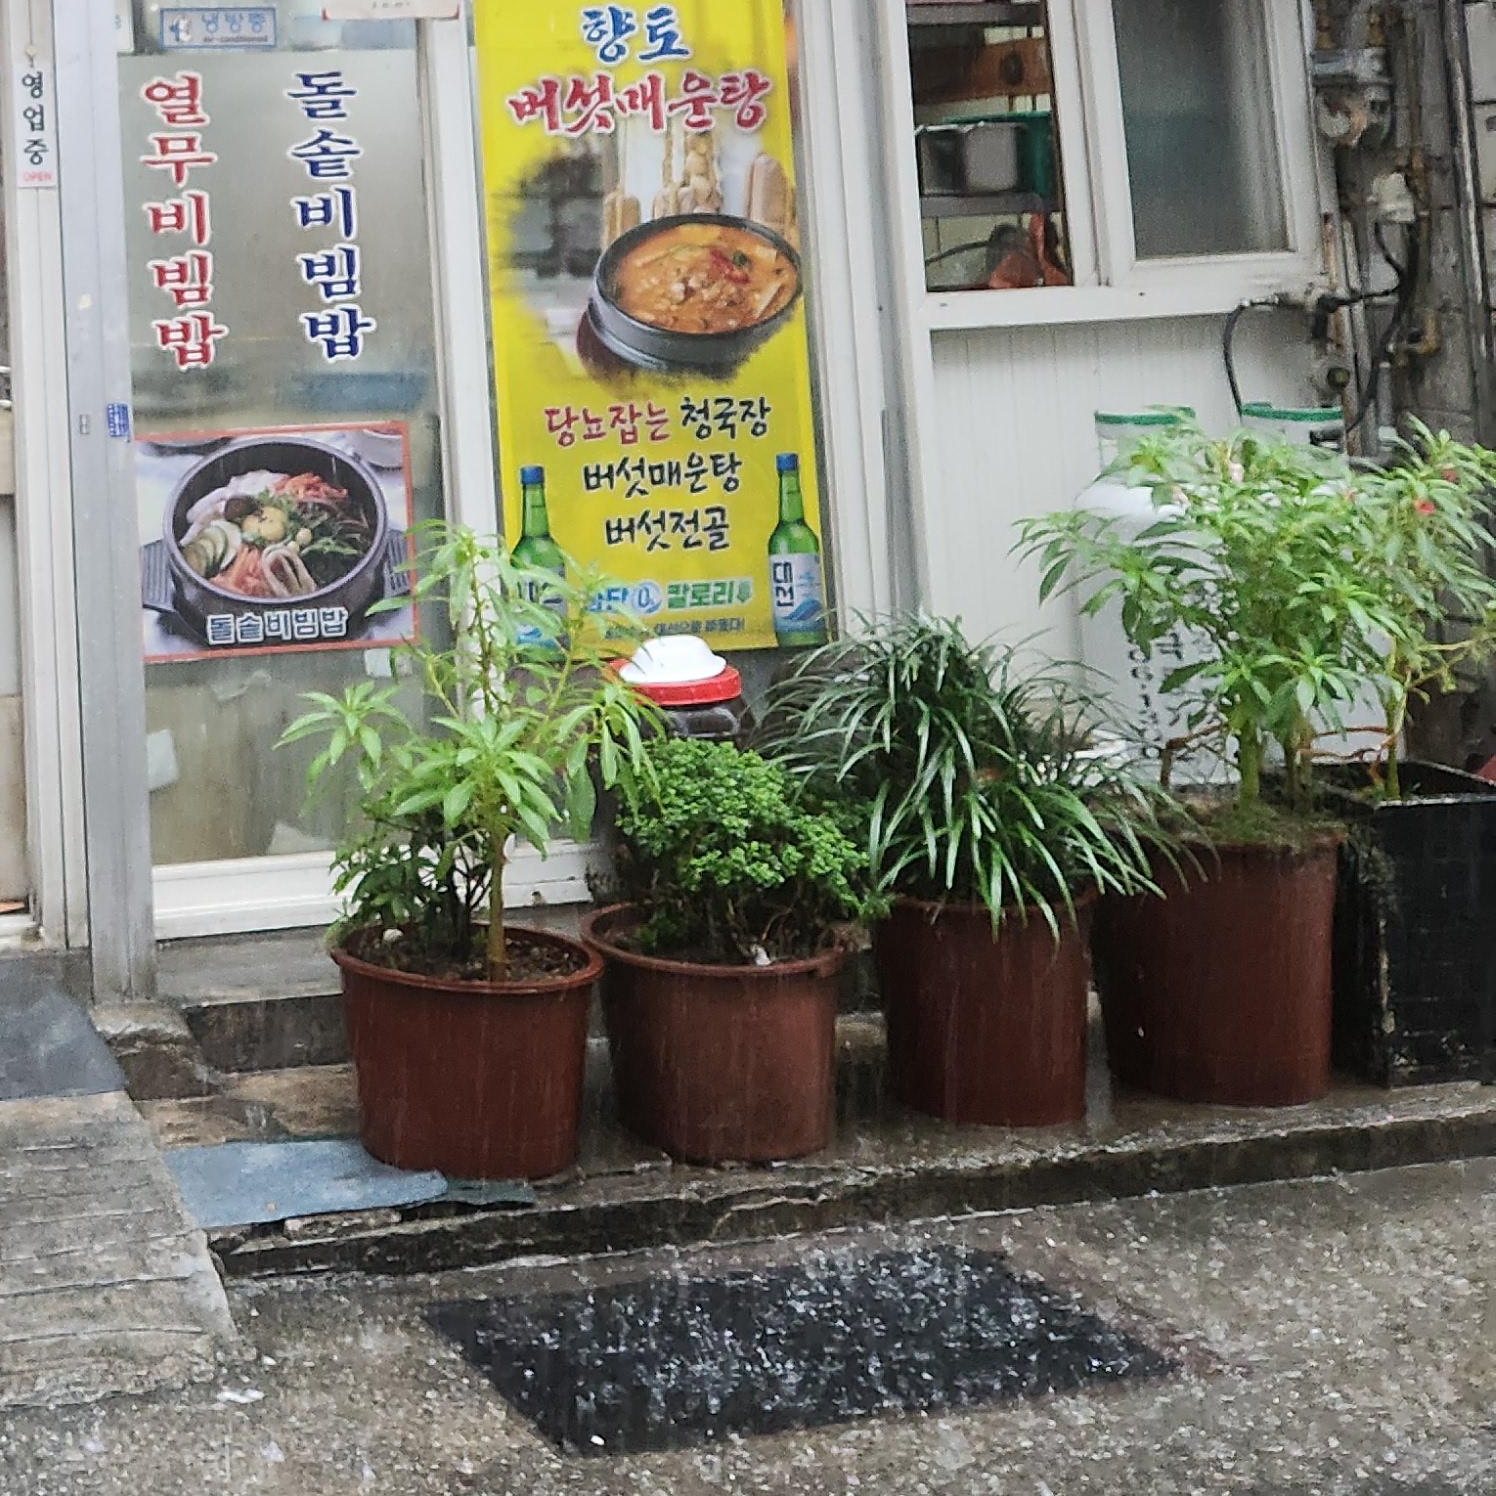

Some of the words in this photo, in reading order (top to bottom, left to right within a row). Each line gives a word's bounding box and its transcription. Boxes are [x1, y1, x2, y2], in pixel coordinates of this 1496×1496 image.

[202, 11, 266, 35] 냉방중
[582, 6, 692, 64] 향토
[21, 70, 50, 166] 영업중
[507, 72, 771, 134] 버섯매운탕
[140, 72, 226, 368] 열무비빔밥
[288, 70, 376, 361] 돌솥비빔밥
[544, 402, 668, 448] 당뇨잡는
[679, 397, 770, 440] 청국장
[583, 452, 741, 499] 버섯매운탕
[605, 505, 729, 551] 버섯전골
